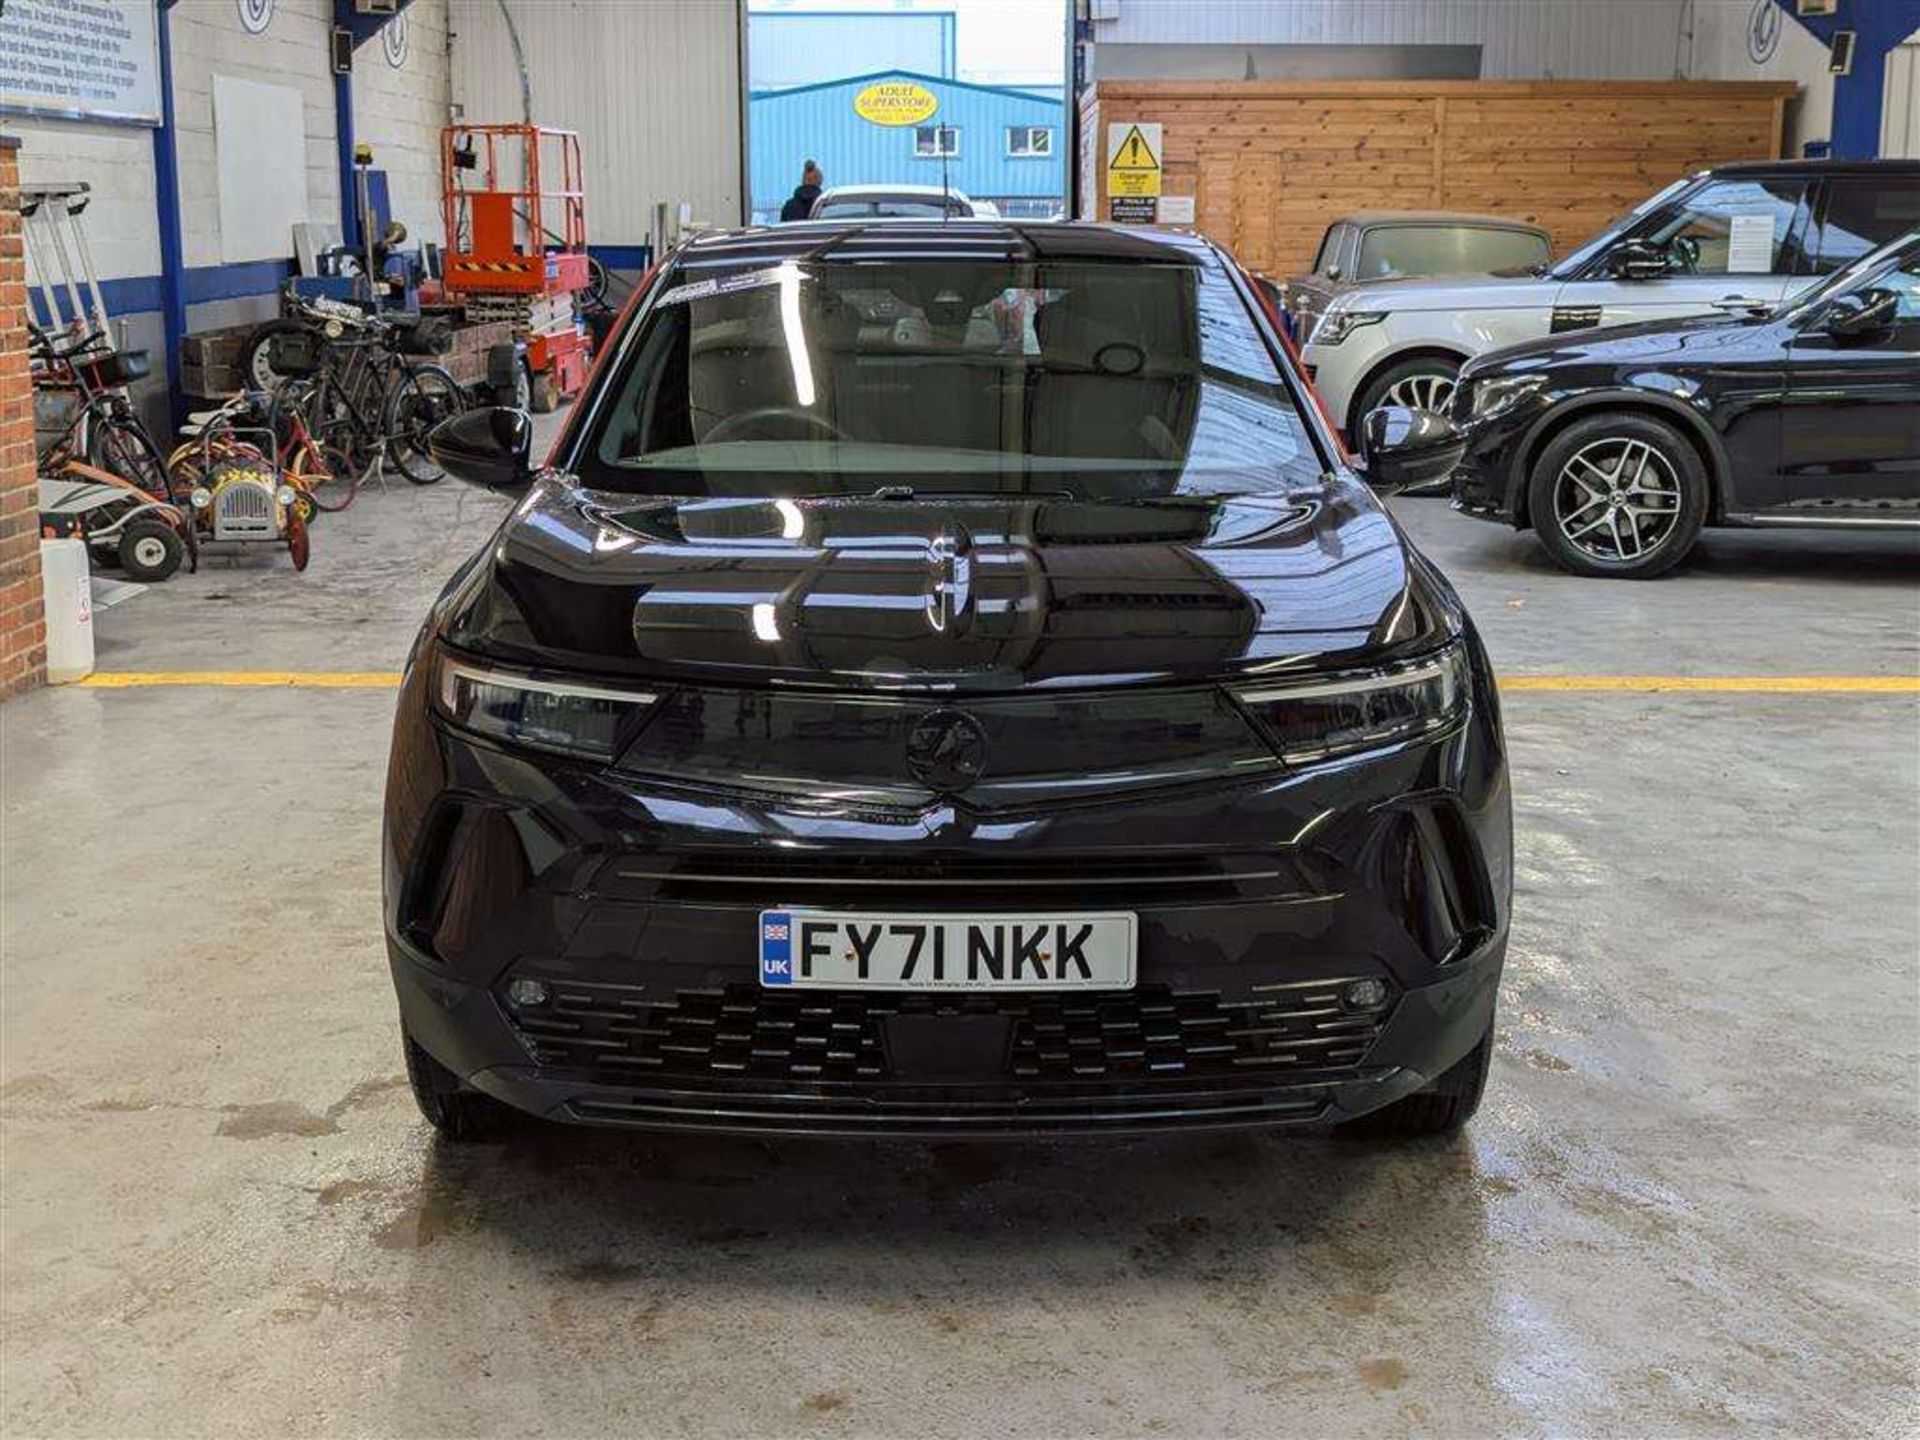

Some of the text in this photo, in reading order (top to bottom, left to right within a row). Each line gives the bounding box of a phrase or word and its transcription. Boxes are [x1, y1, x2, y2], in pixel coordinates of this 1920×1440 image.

[764, 958, 789, 975] UK
[801, 922, 1094, 980] FY71 NKK
